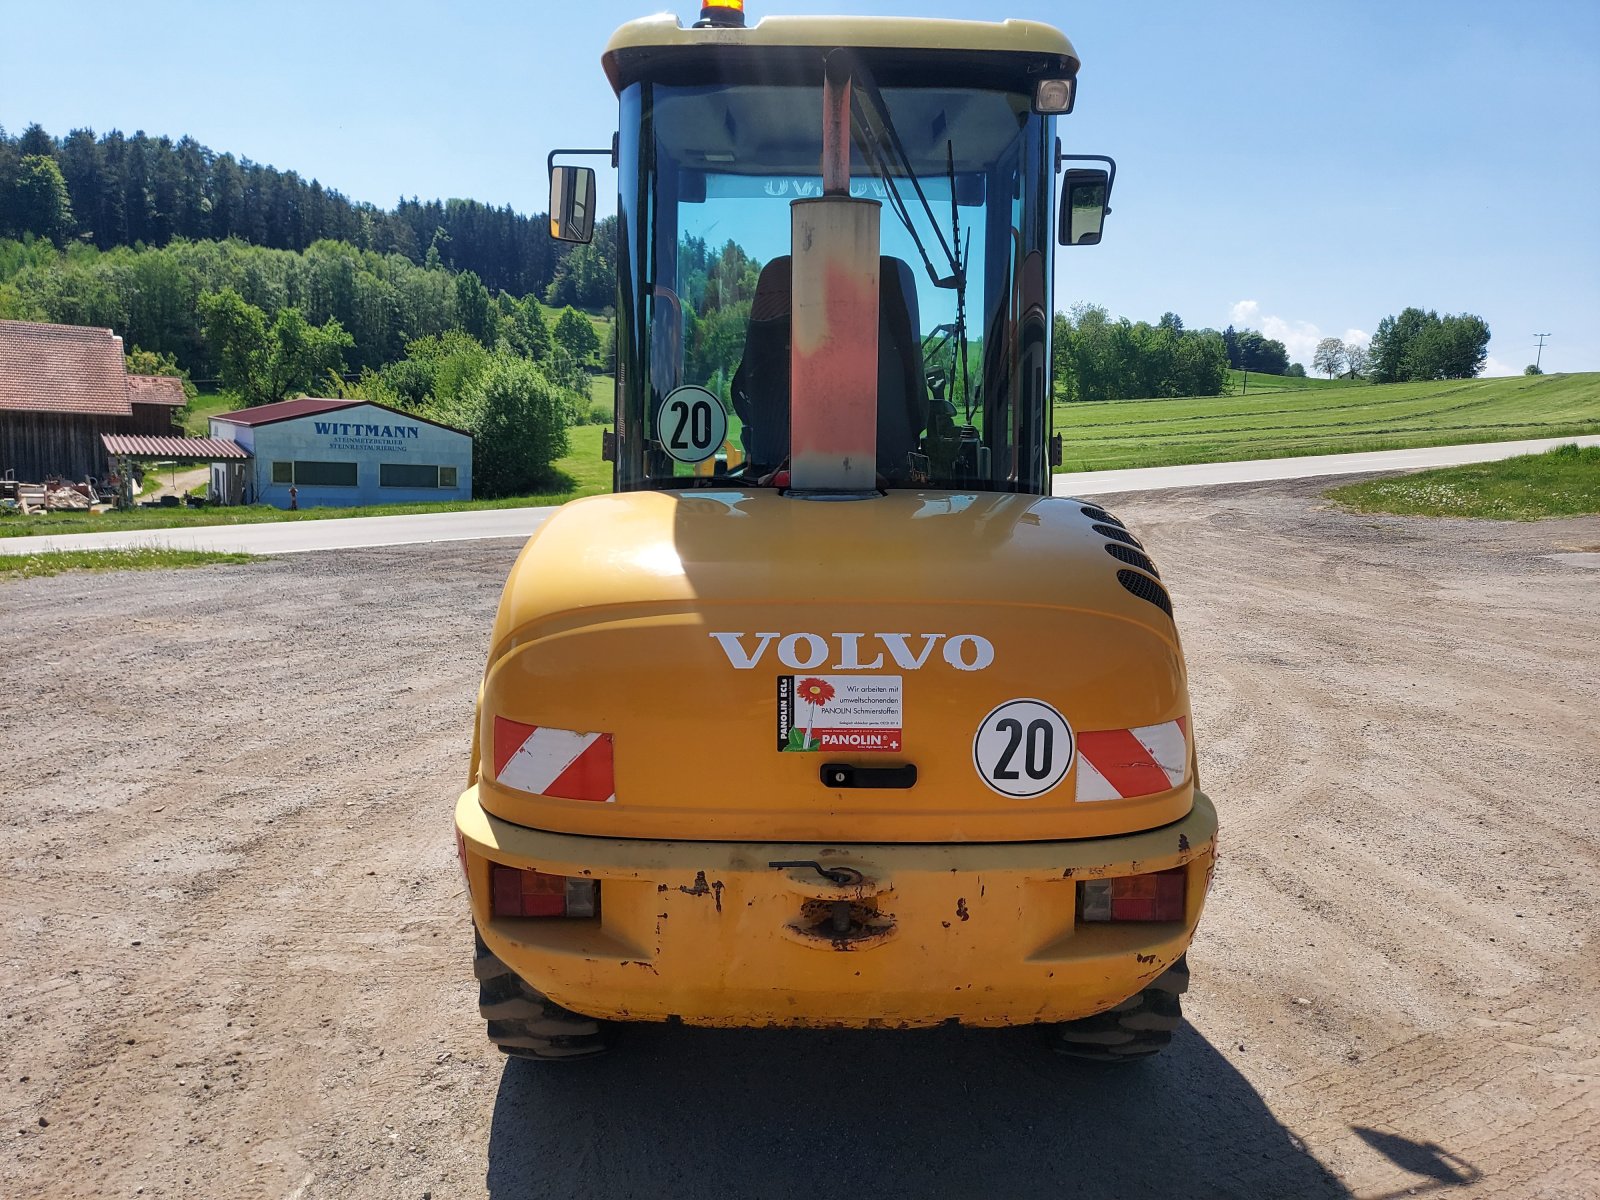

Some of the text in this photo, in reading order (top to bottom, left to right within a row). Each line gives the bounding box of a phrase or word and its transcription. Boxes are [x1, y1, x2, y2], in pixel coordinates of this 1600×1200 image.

[314, 422, 419, 438] WITTMANN
[670, 400, 712, 449] 20
[709, 632, 995, 671] VOLVO
[847, 685, 899, 693] Wir arbeiten mit
[780, 700, 788, 740] PANOLIN
[821, 706, 899, 715] PANOLIN Schmierstoffen
[993, 718, 1053, 780] 20
